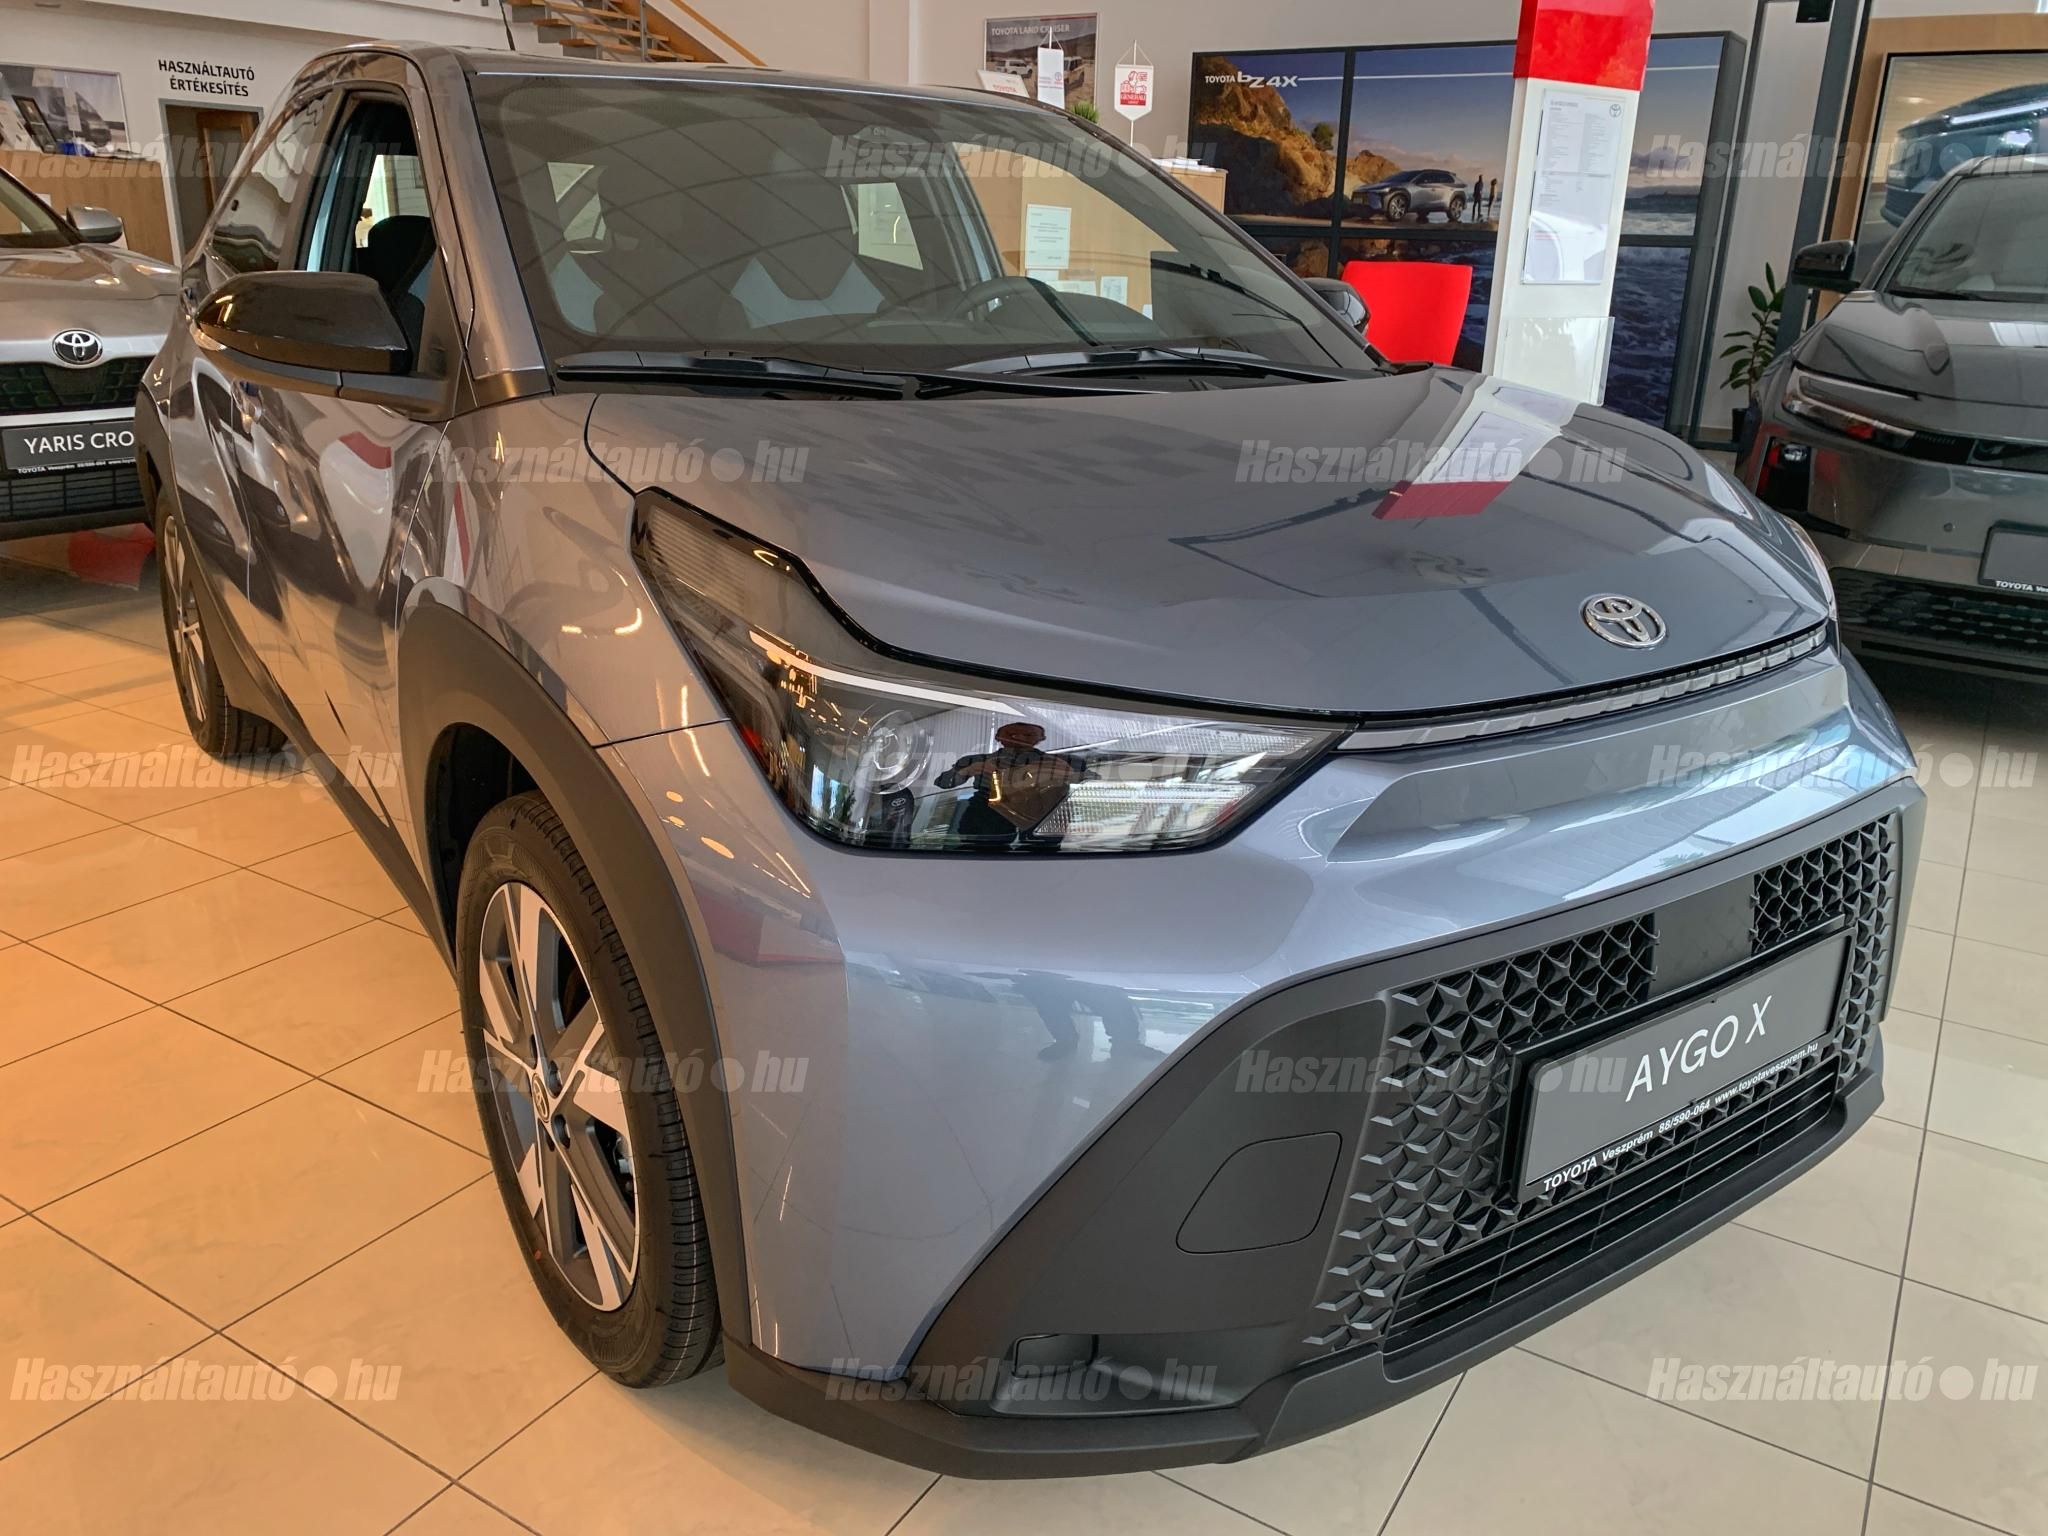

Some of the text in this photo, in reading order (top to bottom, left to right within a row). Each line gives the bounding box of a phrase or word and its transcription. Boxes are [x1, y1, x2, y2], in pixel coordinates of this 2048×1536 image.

[991, 27, 1018, 36] TOYOTA
[1020, 25, 1039, 34] LAND
[158, 59, 255, 80] HASZNÁLTAUTÓ
[1205, 75, 1236, 84] TOYOTA
[170, 75, 249, 96] ÉRTÉKESÍTÉS
[24, 431, 135, 454] YARIS CRO
[18, 466, 46, 474] TOYOTA
[1996, 580, 2033, 591] TOYOTA
[1625, 995, 1772, 1102] AYGO X
[1543, 1042, 1818, 1191] TOYOTA Veszprém 88/590-064 www.toyotaveszprem.hu
